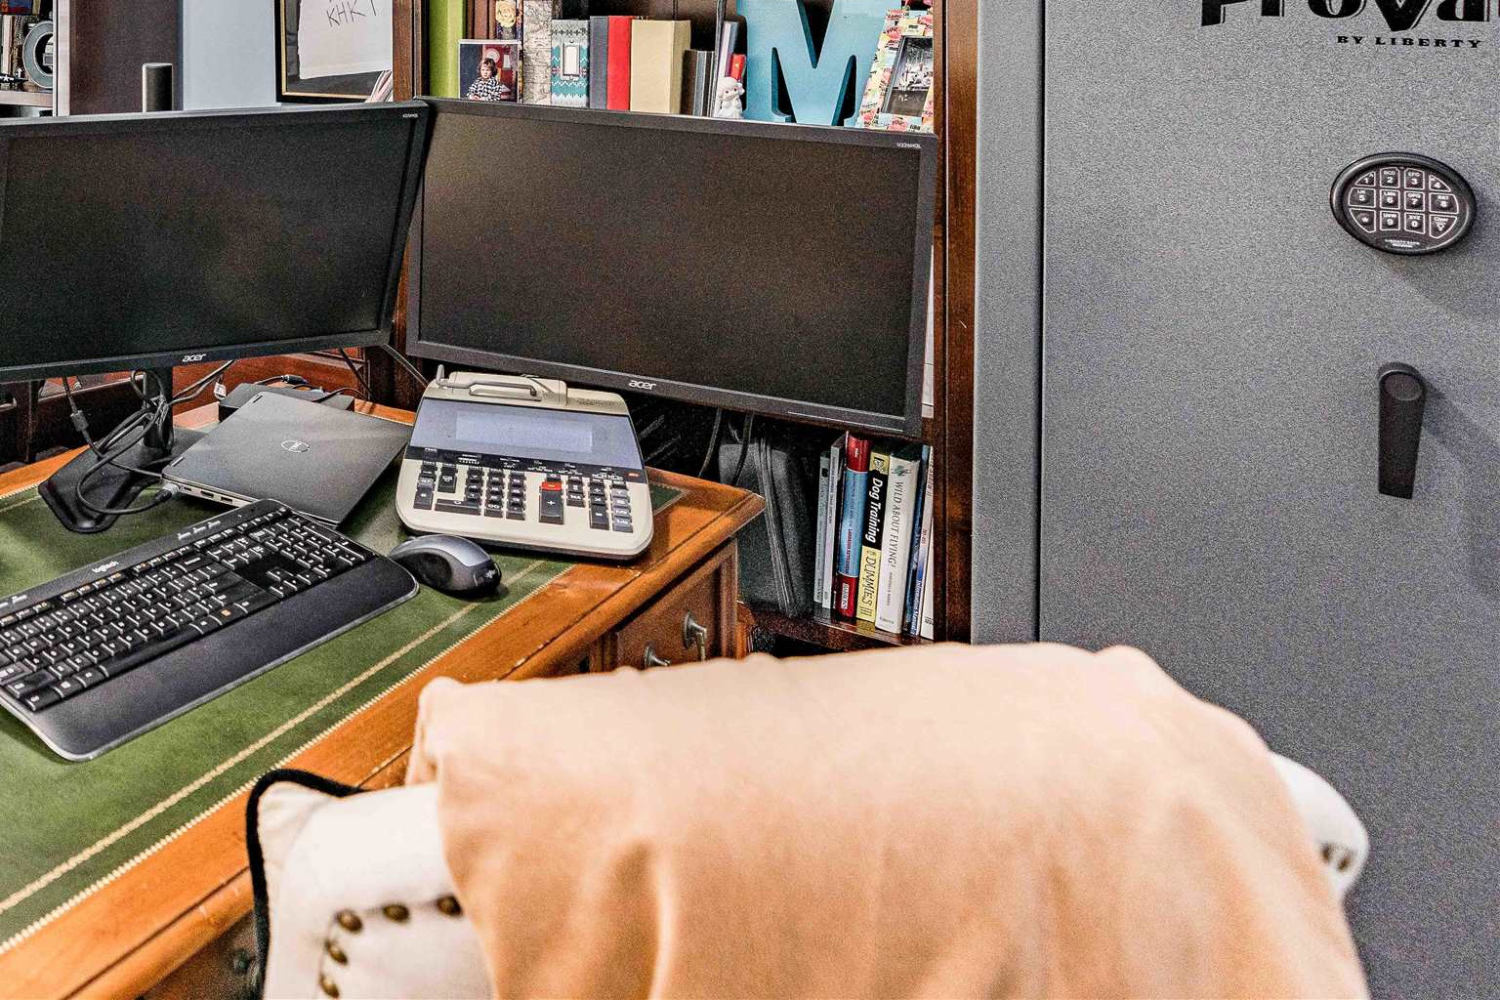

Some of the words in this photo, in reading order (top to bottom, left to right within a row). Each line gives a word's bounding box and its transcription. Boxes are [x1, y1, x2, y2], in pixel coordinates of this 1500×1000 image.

[1337, 36, 1364, 44] BY
[1375, 37, 1482, 48] LIBERTY
[182, 353, 206, 362] acer
[629, 380, 657, 390] acer
[869, 477, 884, 500] Dog
[894, 481, 904, 503] WILD
[864, 502, 882, 544] Training
[892, 504, 902, 533] ABOUT
[888, 534, 899, 568] FLYING!
[861, 556, 876, 606] DUMMIES
